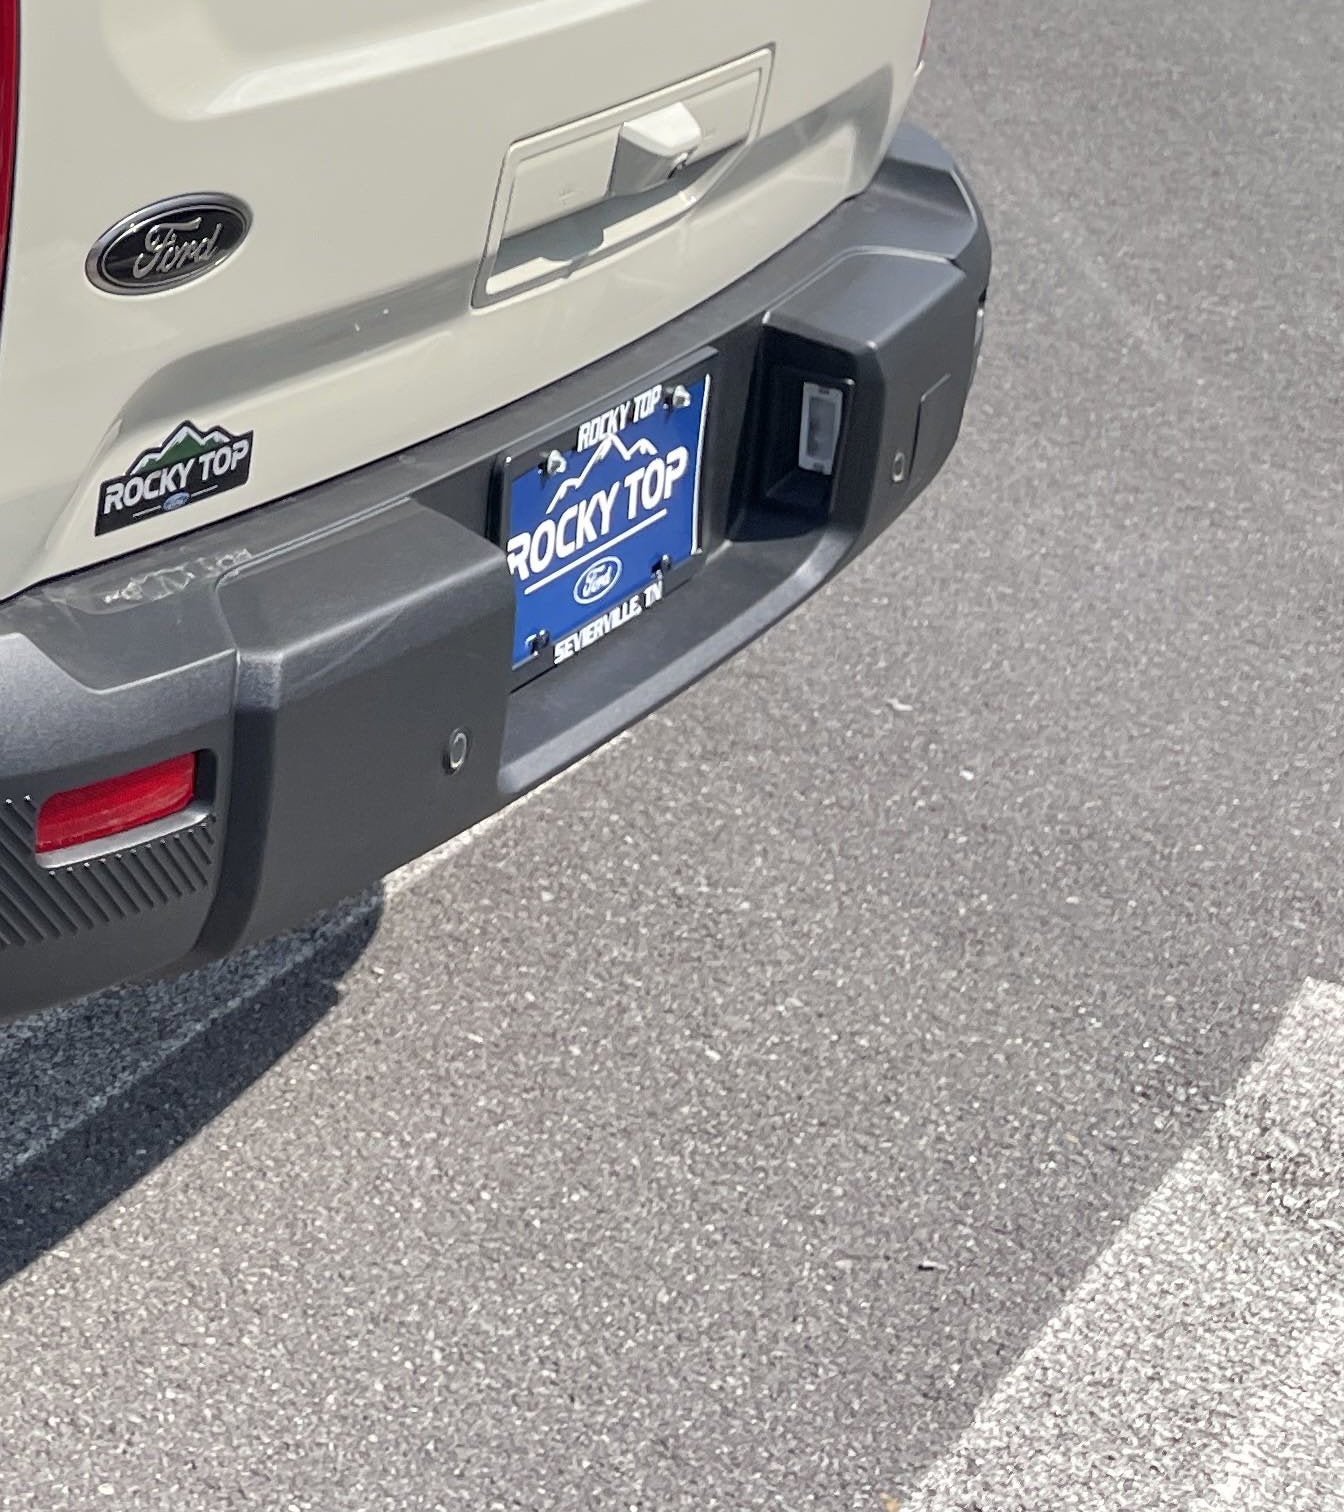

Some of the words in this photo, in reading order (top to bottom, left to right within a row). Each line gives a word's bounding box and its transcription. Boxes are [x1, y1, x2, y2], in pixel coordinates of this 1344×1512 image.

[132, 216, 223, 280] Ford
[576, 400, 631, 453] ROCKY
[632, 384, 663, 423] TOP
[103, 458, 197, 515] ROCKY
[198, 438, 250, 481] TOP
[507, 481, 620, 582] ROCKY
[624, 445, 689, 520] TOP
[582, 564, 612, 599] Ford
[643, 580, 663, 609] TN
